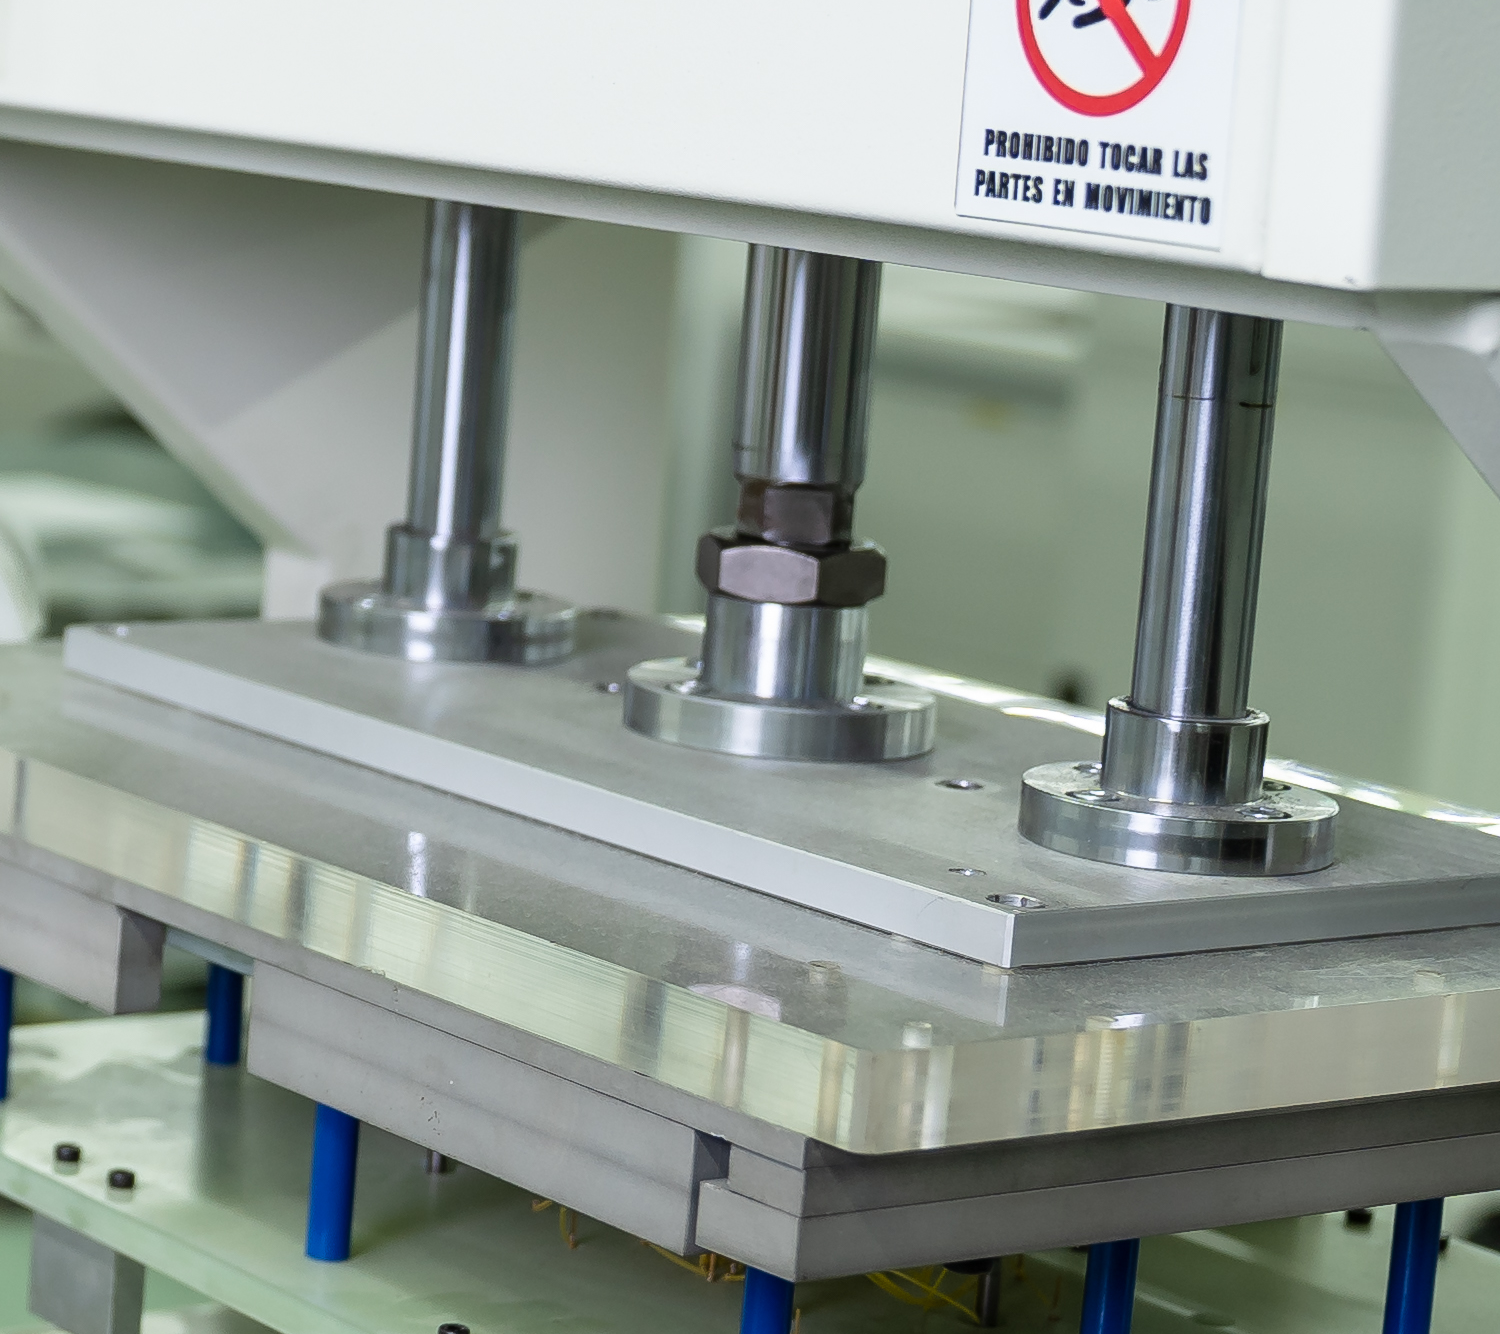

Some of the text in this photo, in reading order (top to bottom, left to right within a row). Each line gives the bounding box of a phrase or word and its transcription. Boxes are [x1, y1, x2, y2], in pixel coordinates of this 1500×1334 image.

[984, 128, 1208, 181] PROHIBIDO TOCAR LAS
[973, 168, 1212, 226] PARTES EN MOVIMIENTO
